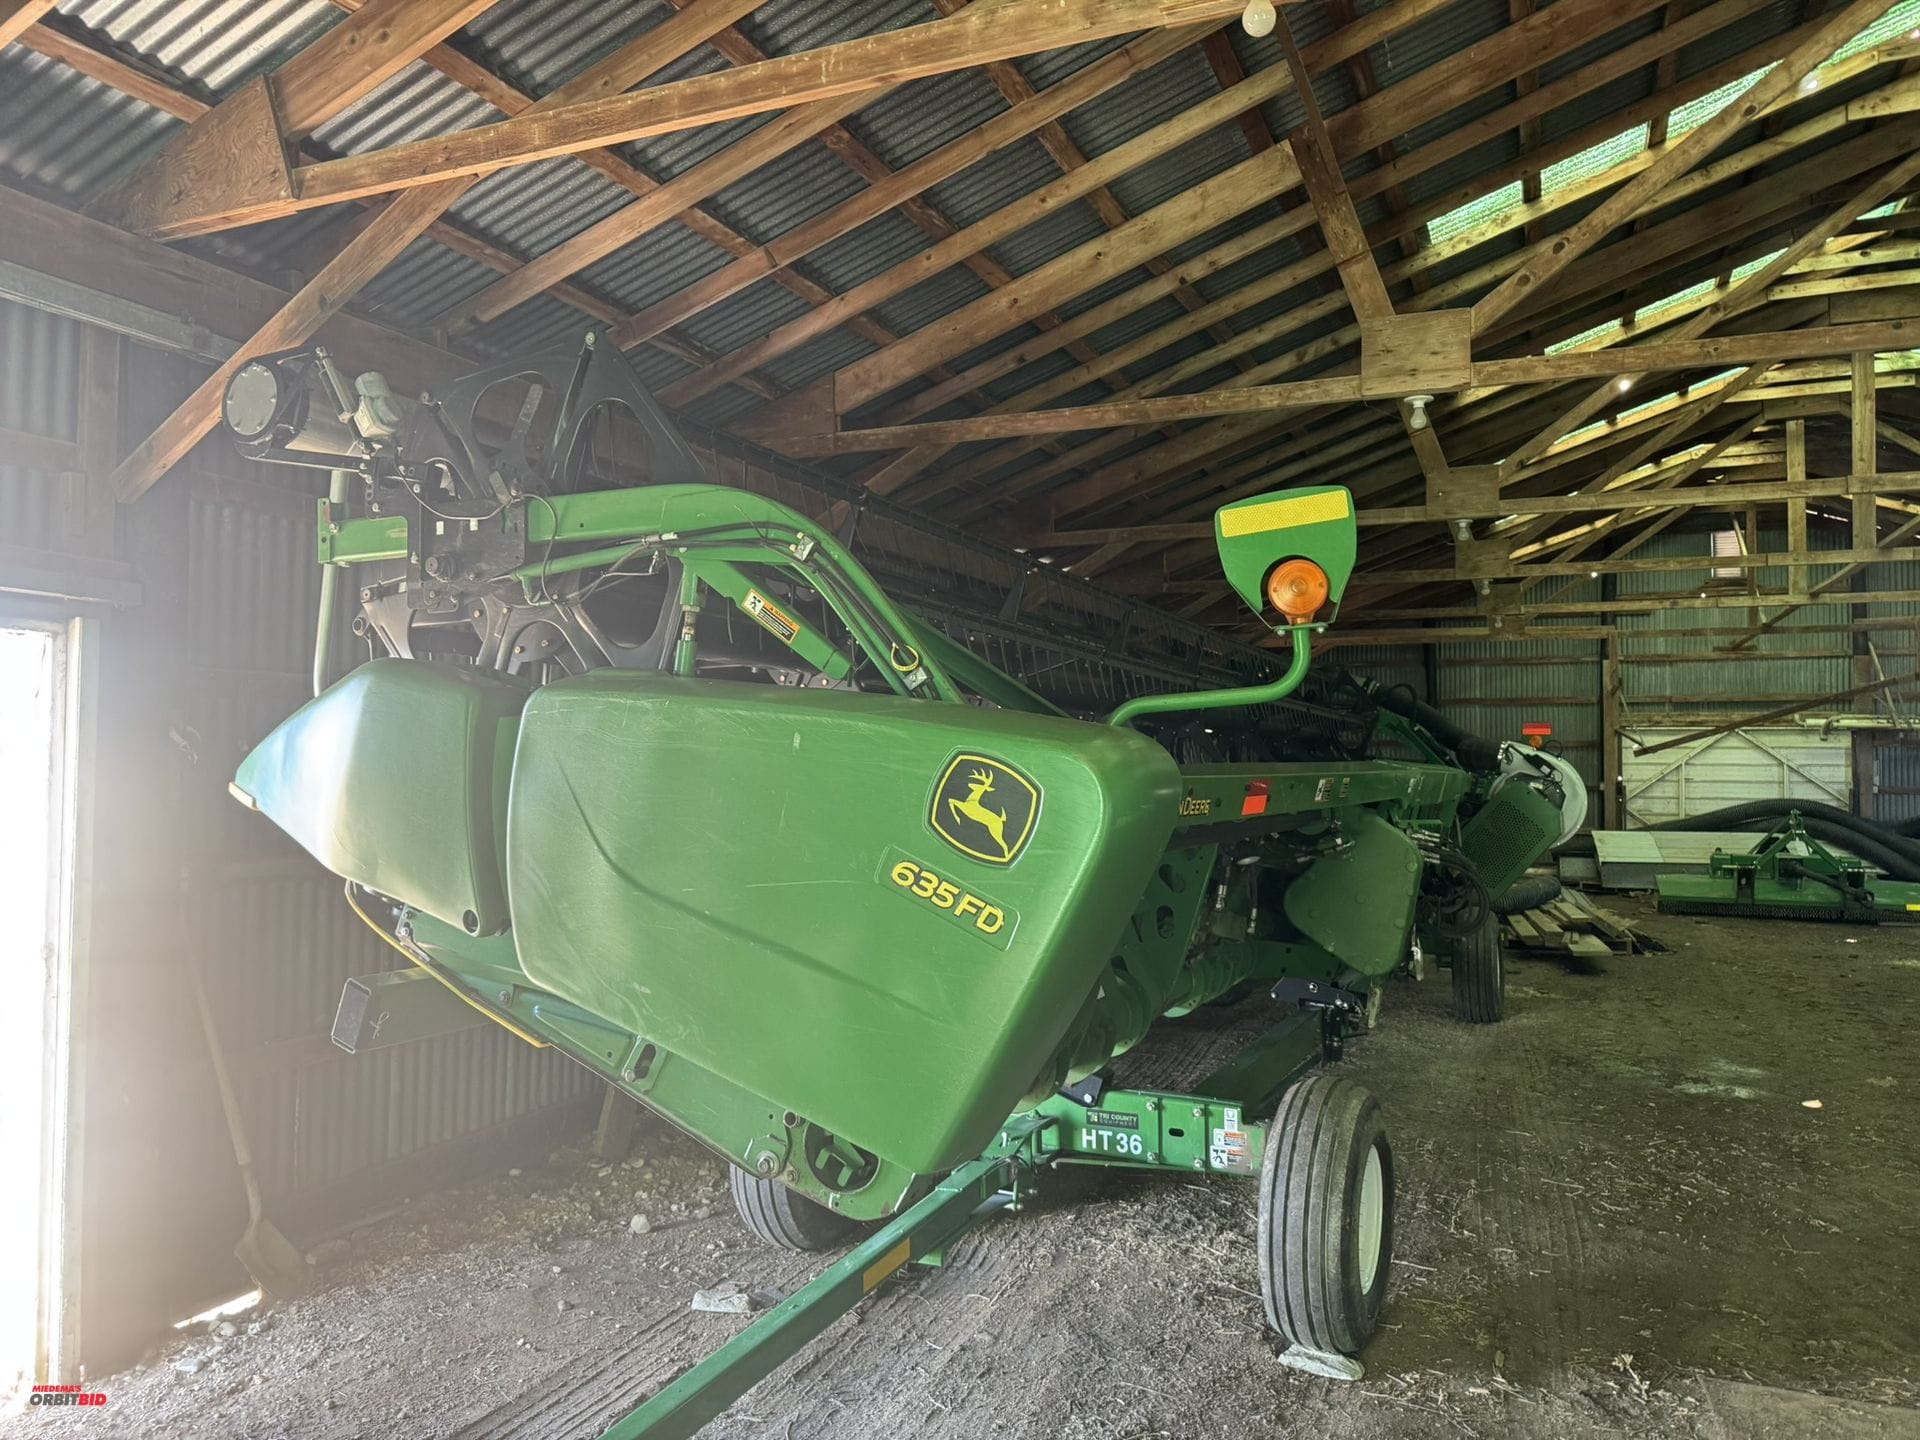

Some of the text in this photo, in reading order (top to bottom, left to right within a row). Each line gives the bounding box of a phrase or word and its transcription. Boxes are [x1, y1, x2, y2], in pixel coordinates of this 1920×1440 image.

[891, 860, 1005, 934] 635FD
[1111, 1113, 1137, 1122] COUNTY
[1082, 1128, 1143, 1155] HT 36
